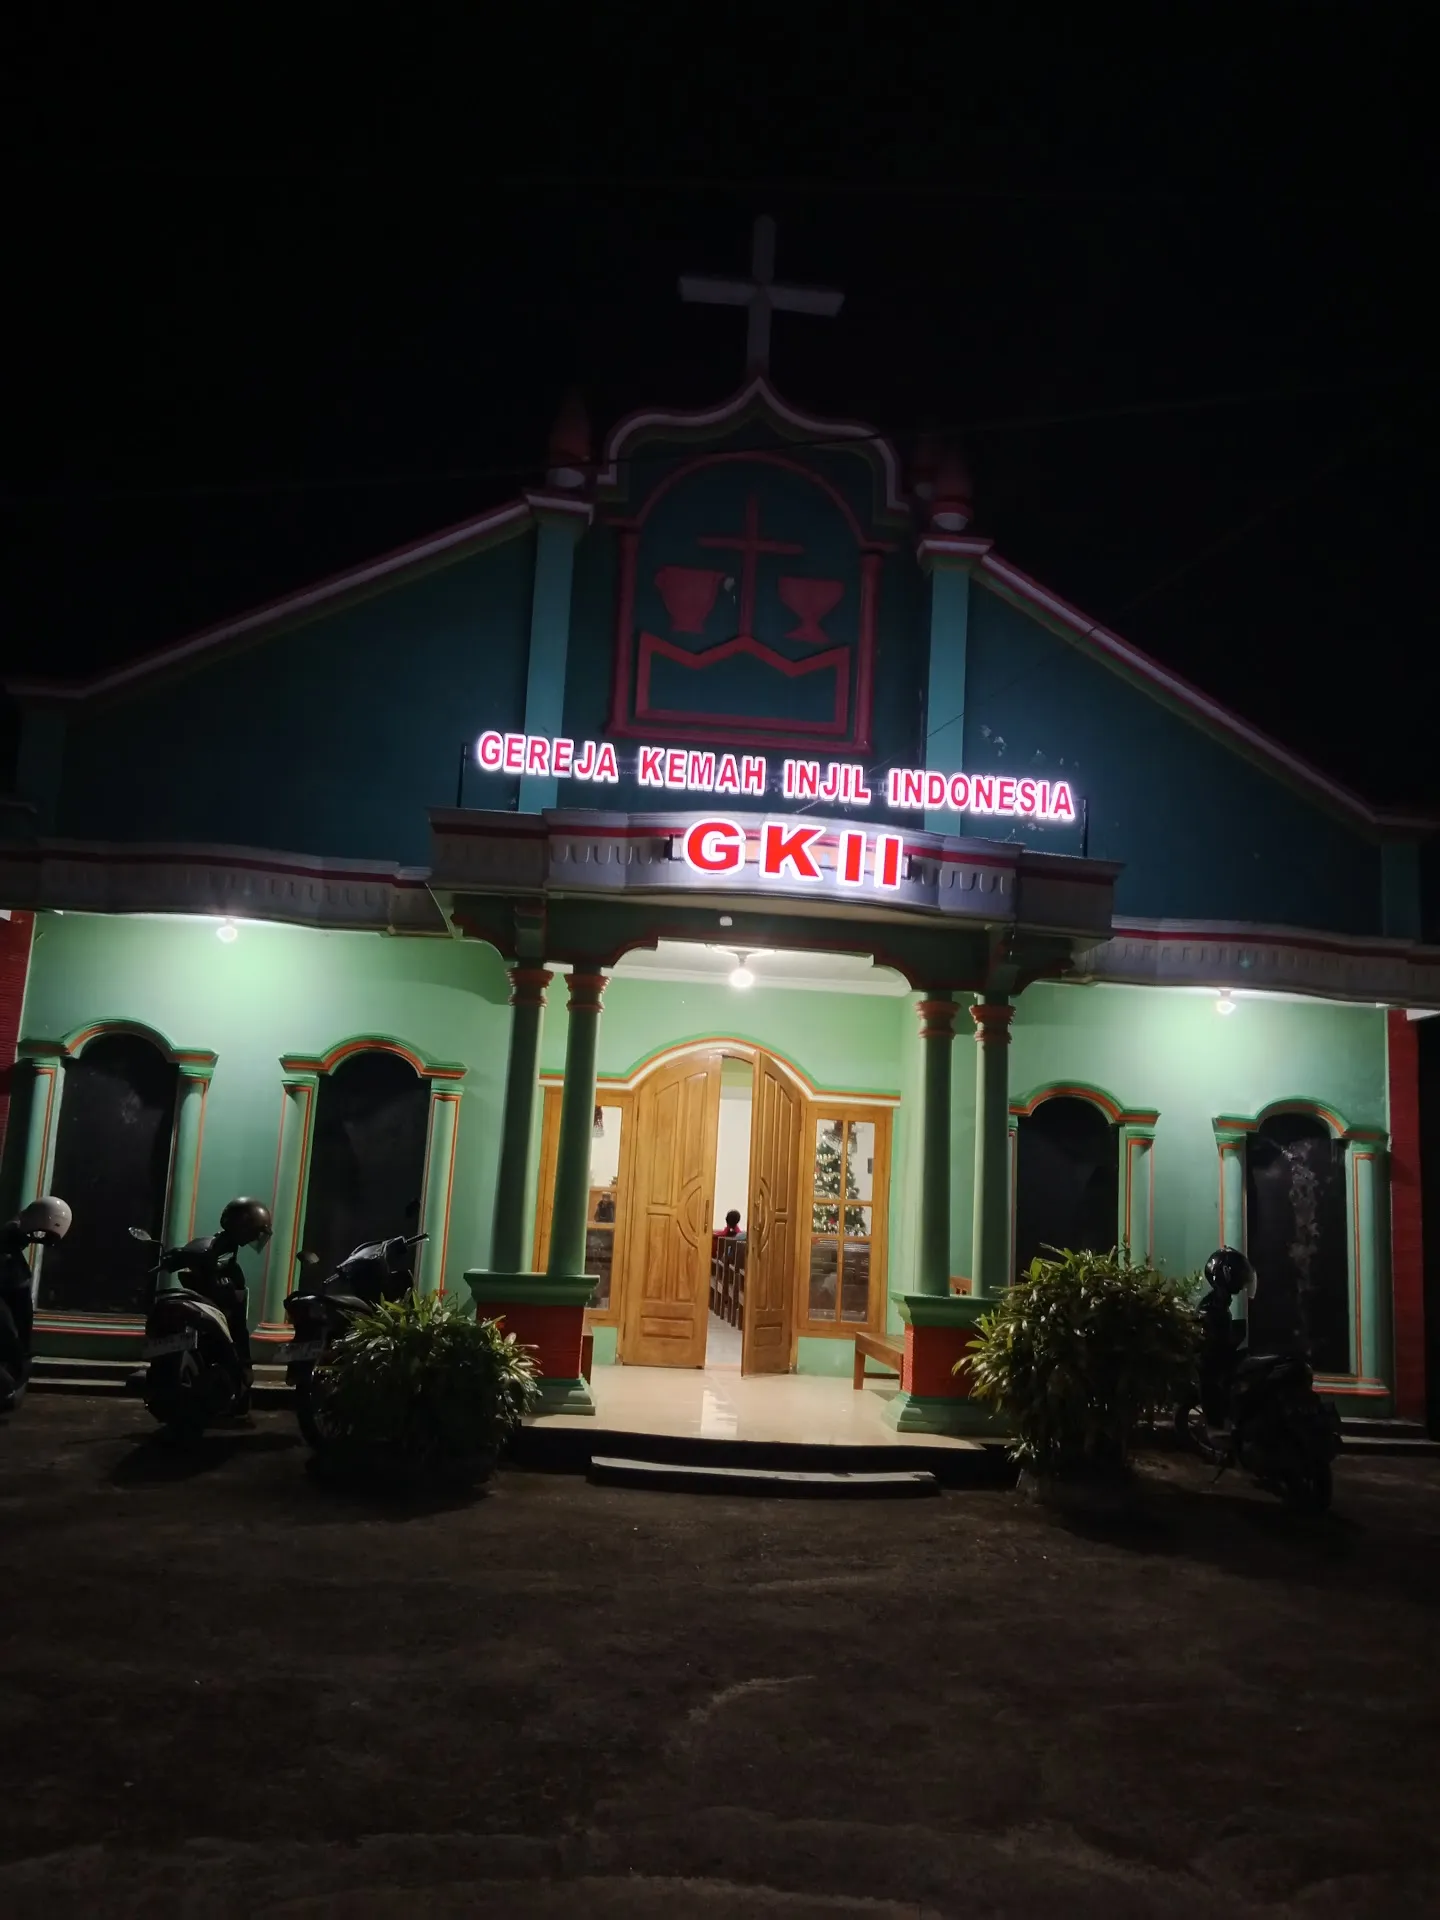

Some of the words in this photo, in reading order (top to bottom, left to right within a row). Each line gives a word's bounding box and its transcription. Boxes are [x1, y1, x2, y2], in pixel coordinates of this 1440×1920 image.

[480, 732, 617, 782] GEREJA
[639, 747, 766, 794] KEMAH
[783, 760, 871, 804] INJIL
[887, 769, 1075, 821] INDONESIA
[684, 819, 902, 890] GKII
